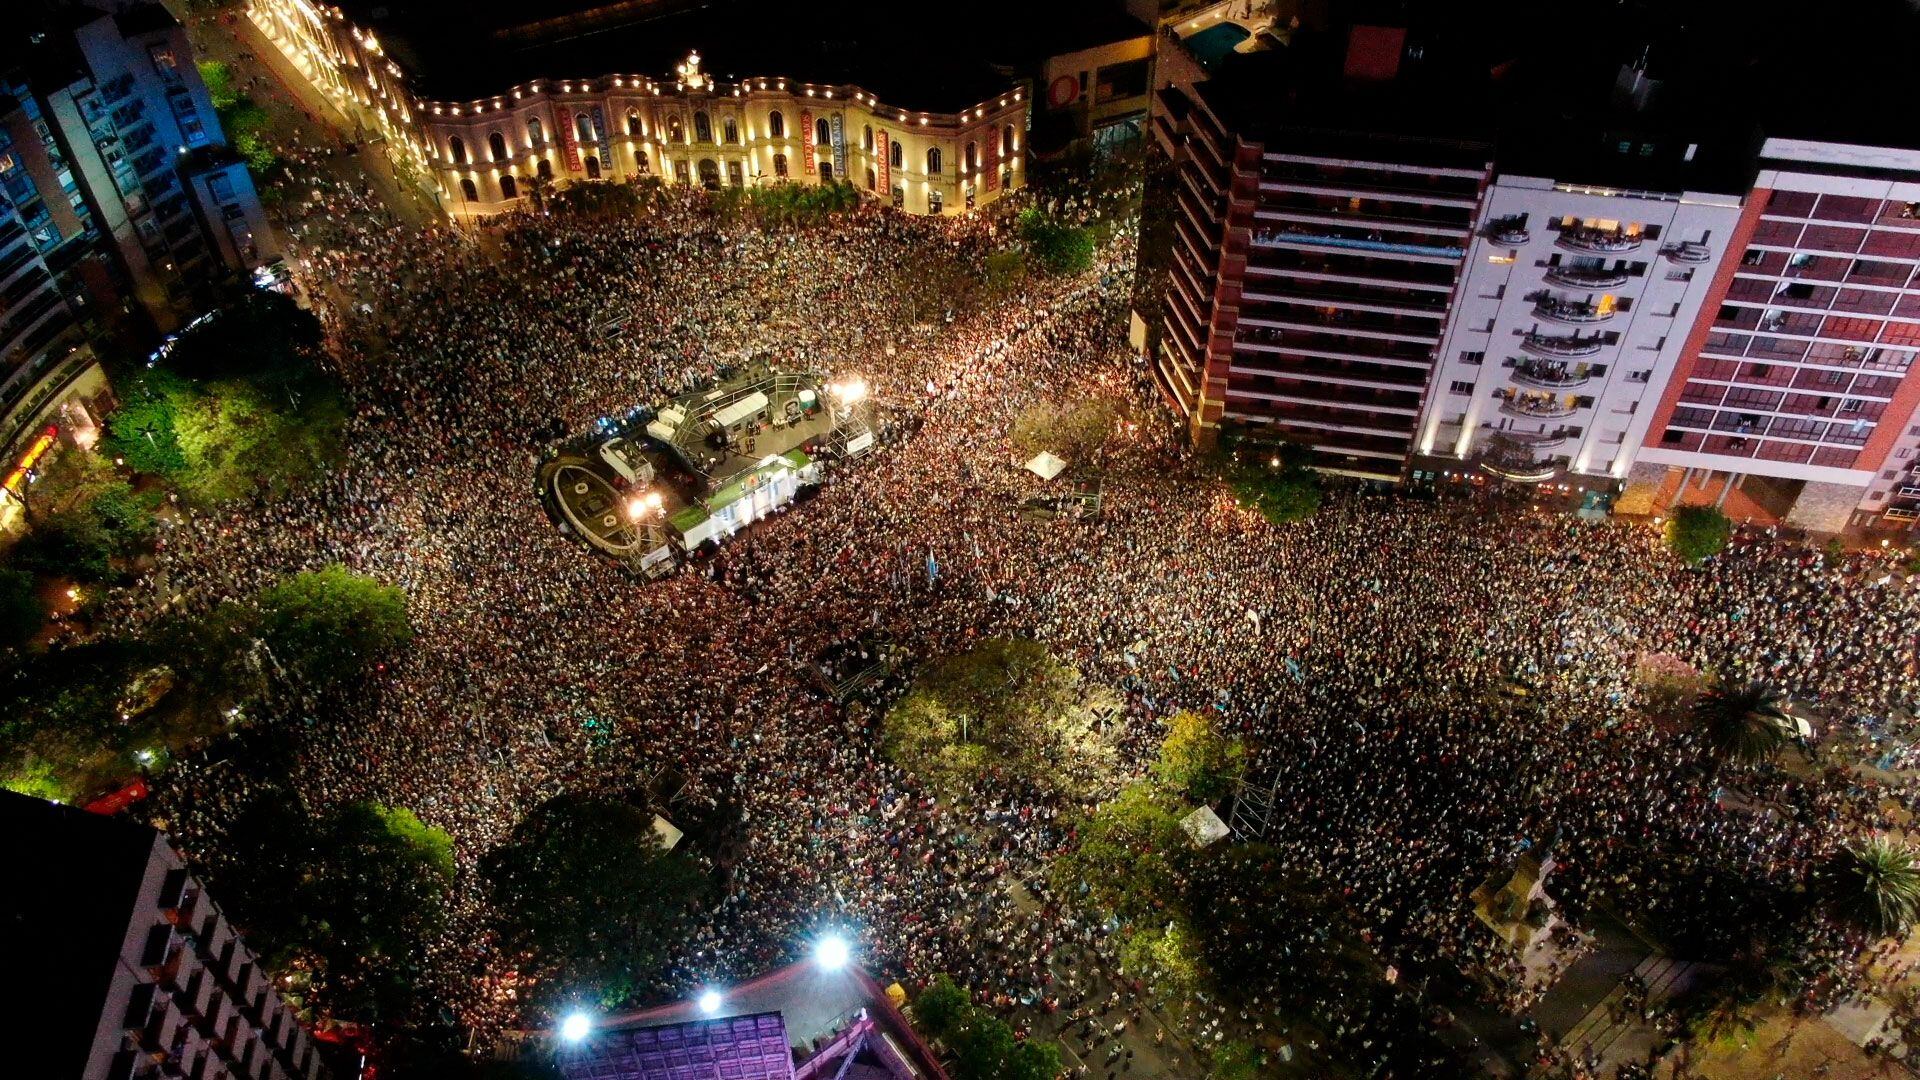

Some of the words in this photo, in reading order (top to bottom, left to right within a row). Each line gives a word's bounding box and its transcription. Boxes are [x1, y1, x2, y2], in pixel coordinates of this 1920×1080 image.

[803, 115, 812, 144] OLMOS
[832, 117, 841, 146] OLMOS
[805, 144, 814, 168] PATIO
[834, 146, 842, 170] PATIO
[877, 135, 886, 163] OLMOS
[879, 163, 888, 188] PATIO
